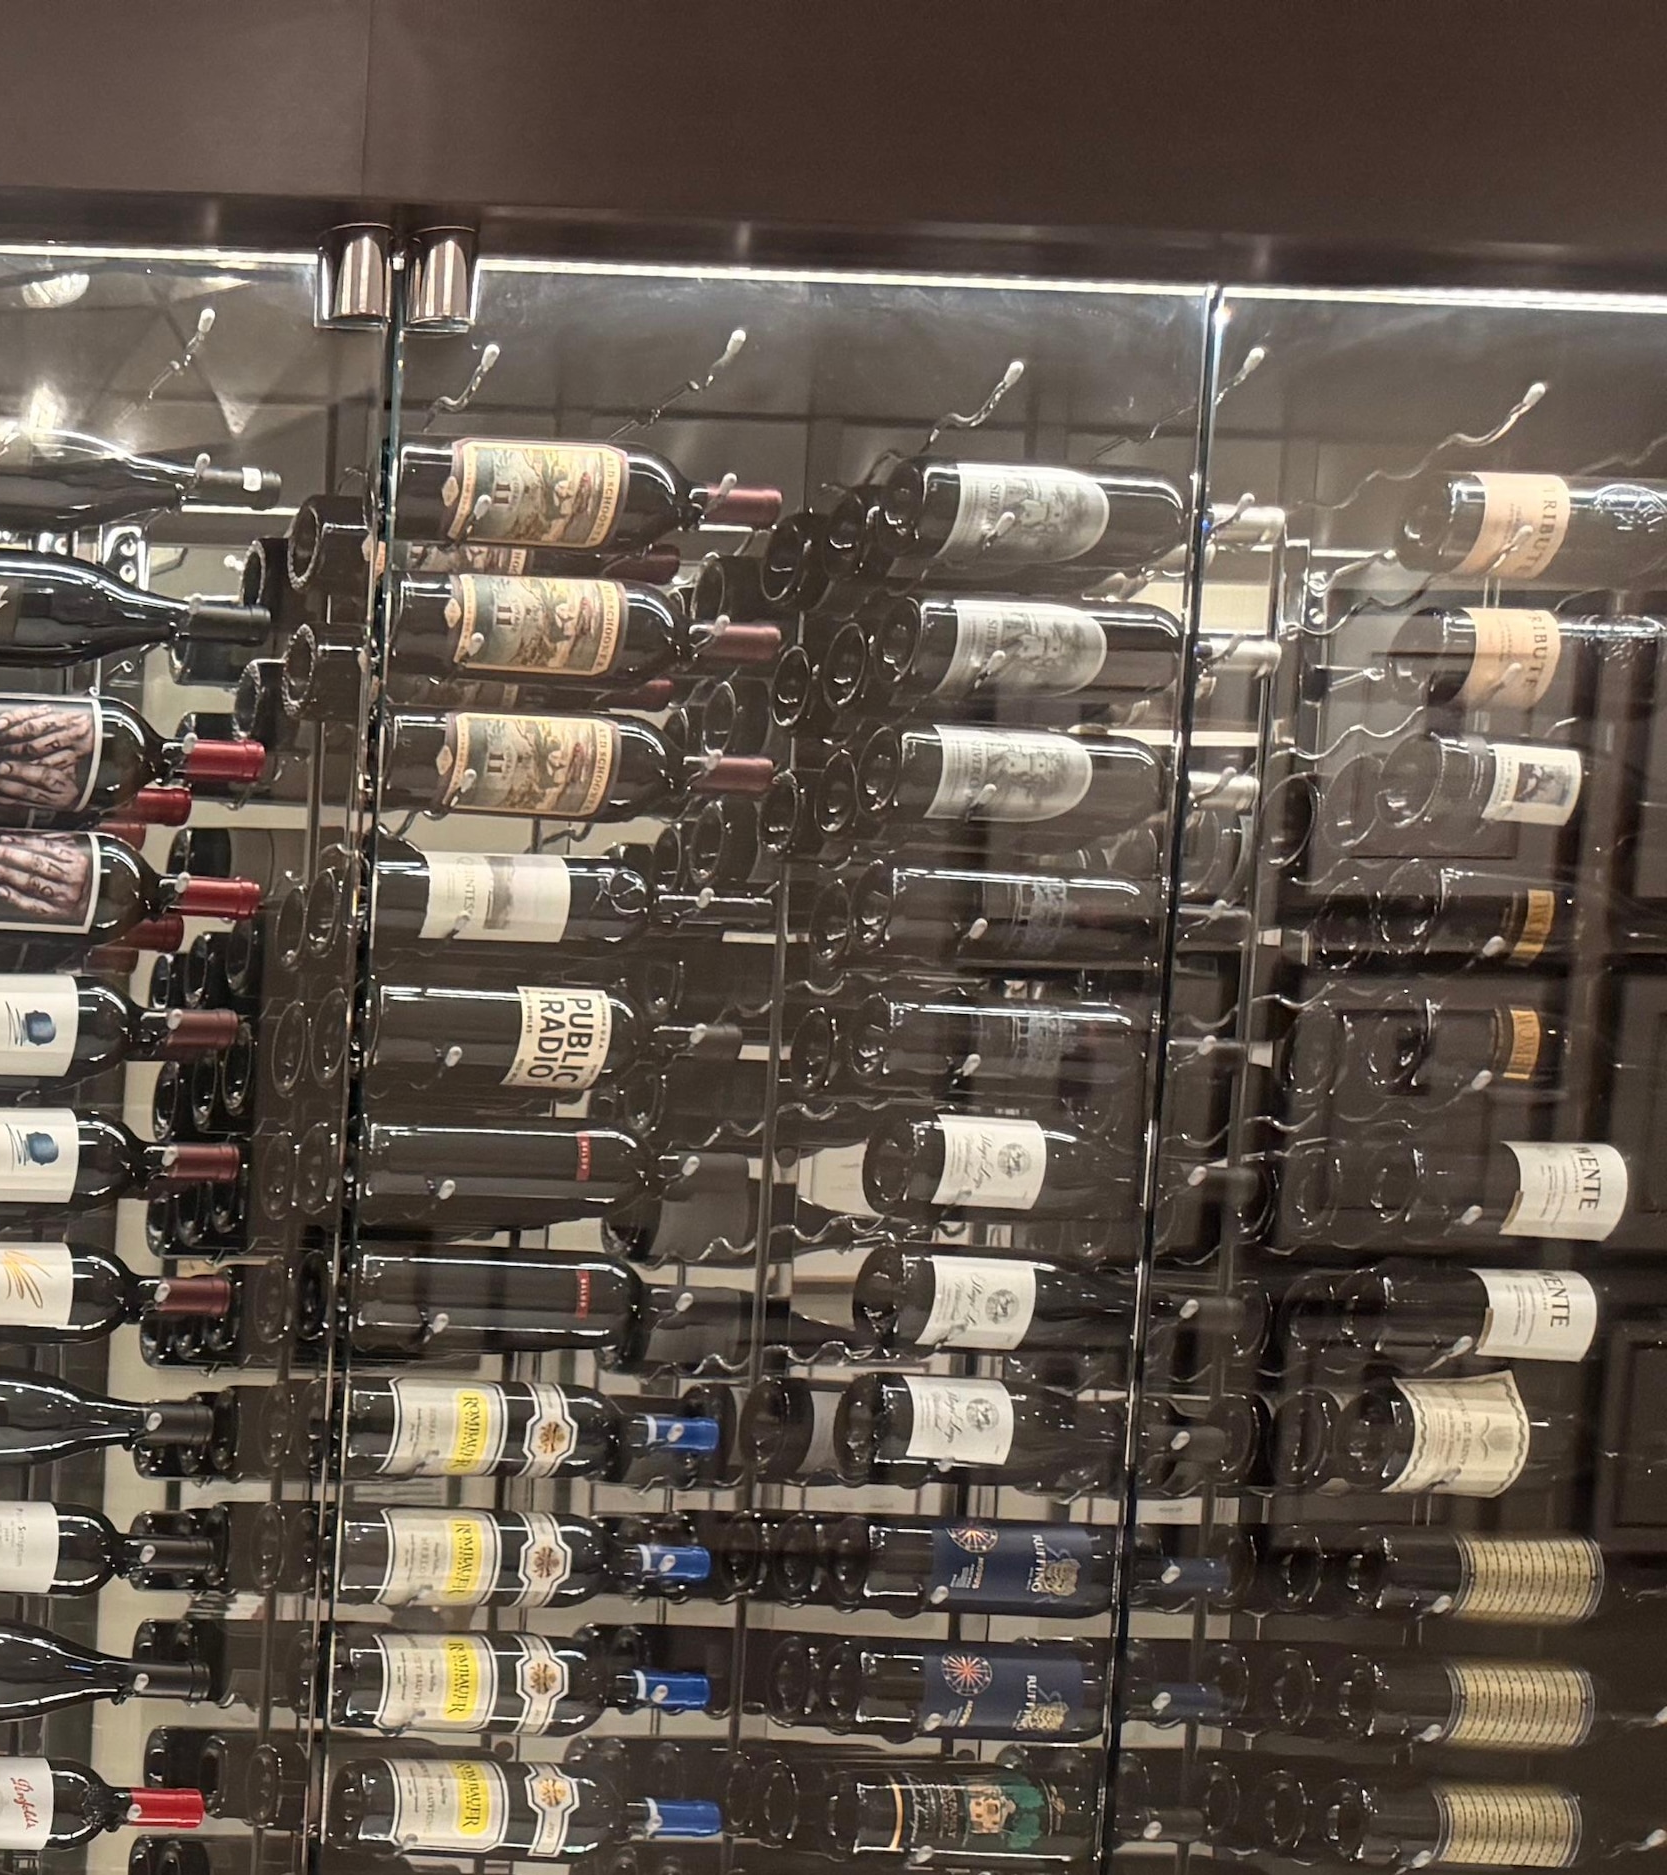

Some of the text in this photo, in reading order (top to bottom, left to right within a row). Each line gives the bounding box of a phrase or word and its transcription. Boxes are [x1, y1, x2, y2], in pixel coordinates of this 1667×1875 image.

[527, 1000, 565, 1079] RADIO
[551, 998, 594, 1084] PUBLIC
[1577, 1147, 1601, 1210] WENTE
[452, 1396, 481, 1470] ROMBAUER
[448, 1522, 477, 1596] ROMBAUER
[1031, 1534, 1047, 1593] RUFFINO
[449, 1642, 471, 1714] ROMBAUER
[11, 1778, 39, 1830] Penfolds
